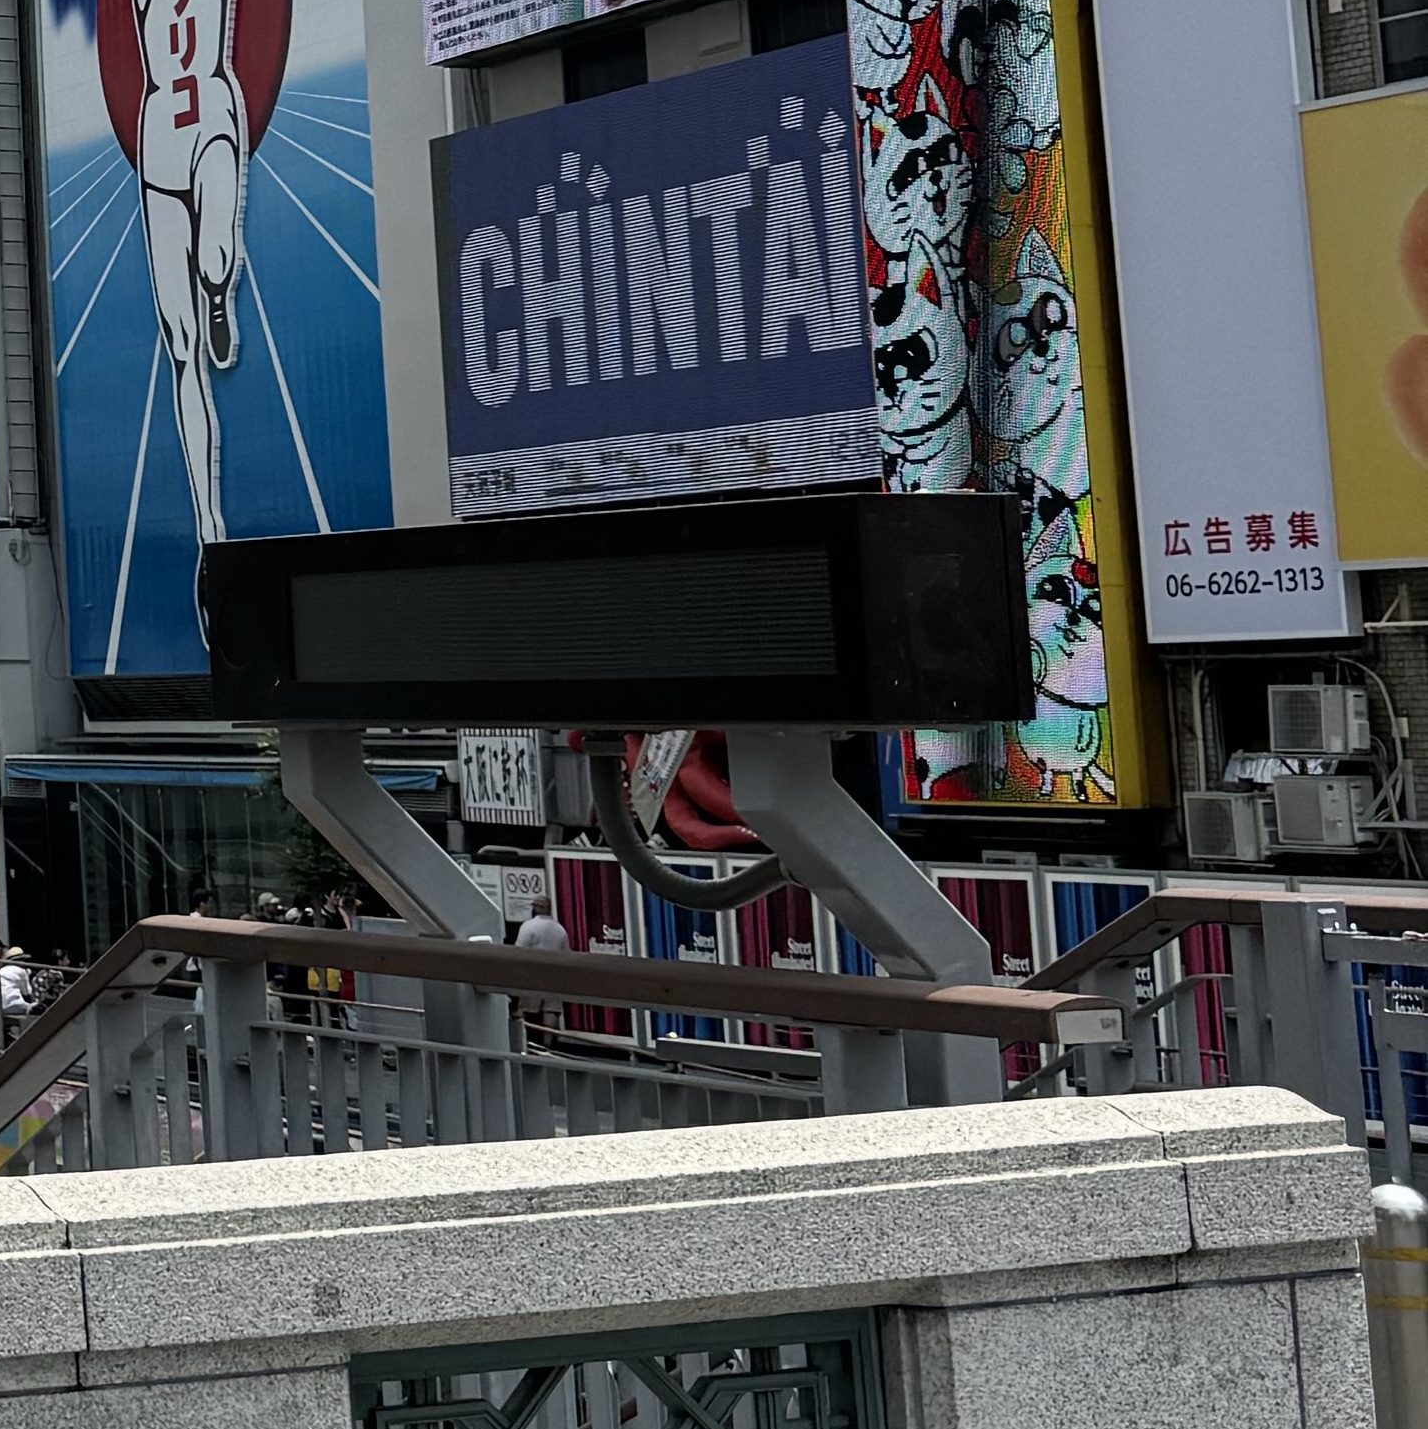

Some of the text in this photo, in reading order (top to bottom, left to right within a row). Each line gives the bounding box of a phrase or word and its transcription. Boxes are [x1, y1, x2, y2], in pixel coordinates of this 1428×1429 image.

[460, 95, 863, 409] CHINTAI
[1163, 510, 1320, 558] 広告募集
[1166, 566, 1325, 598] 06-6262-1313
